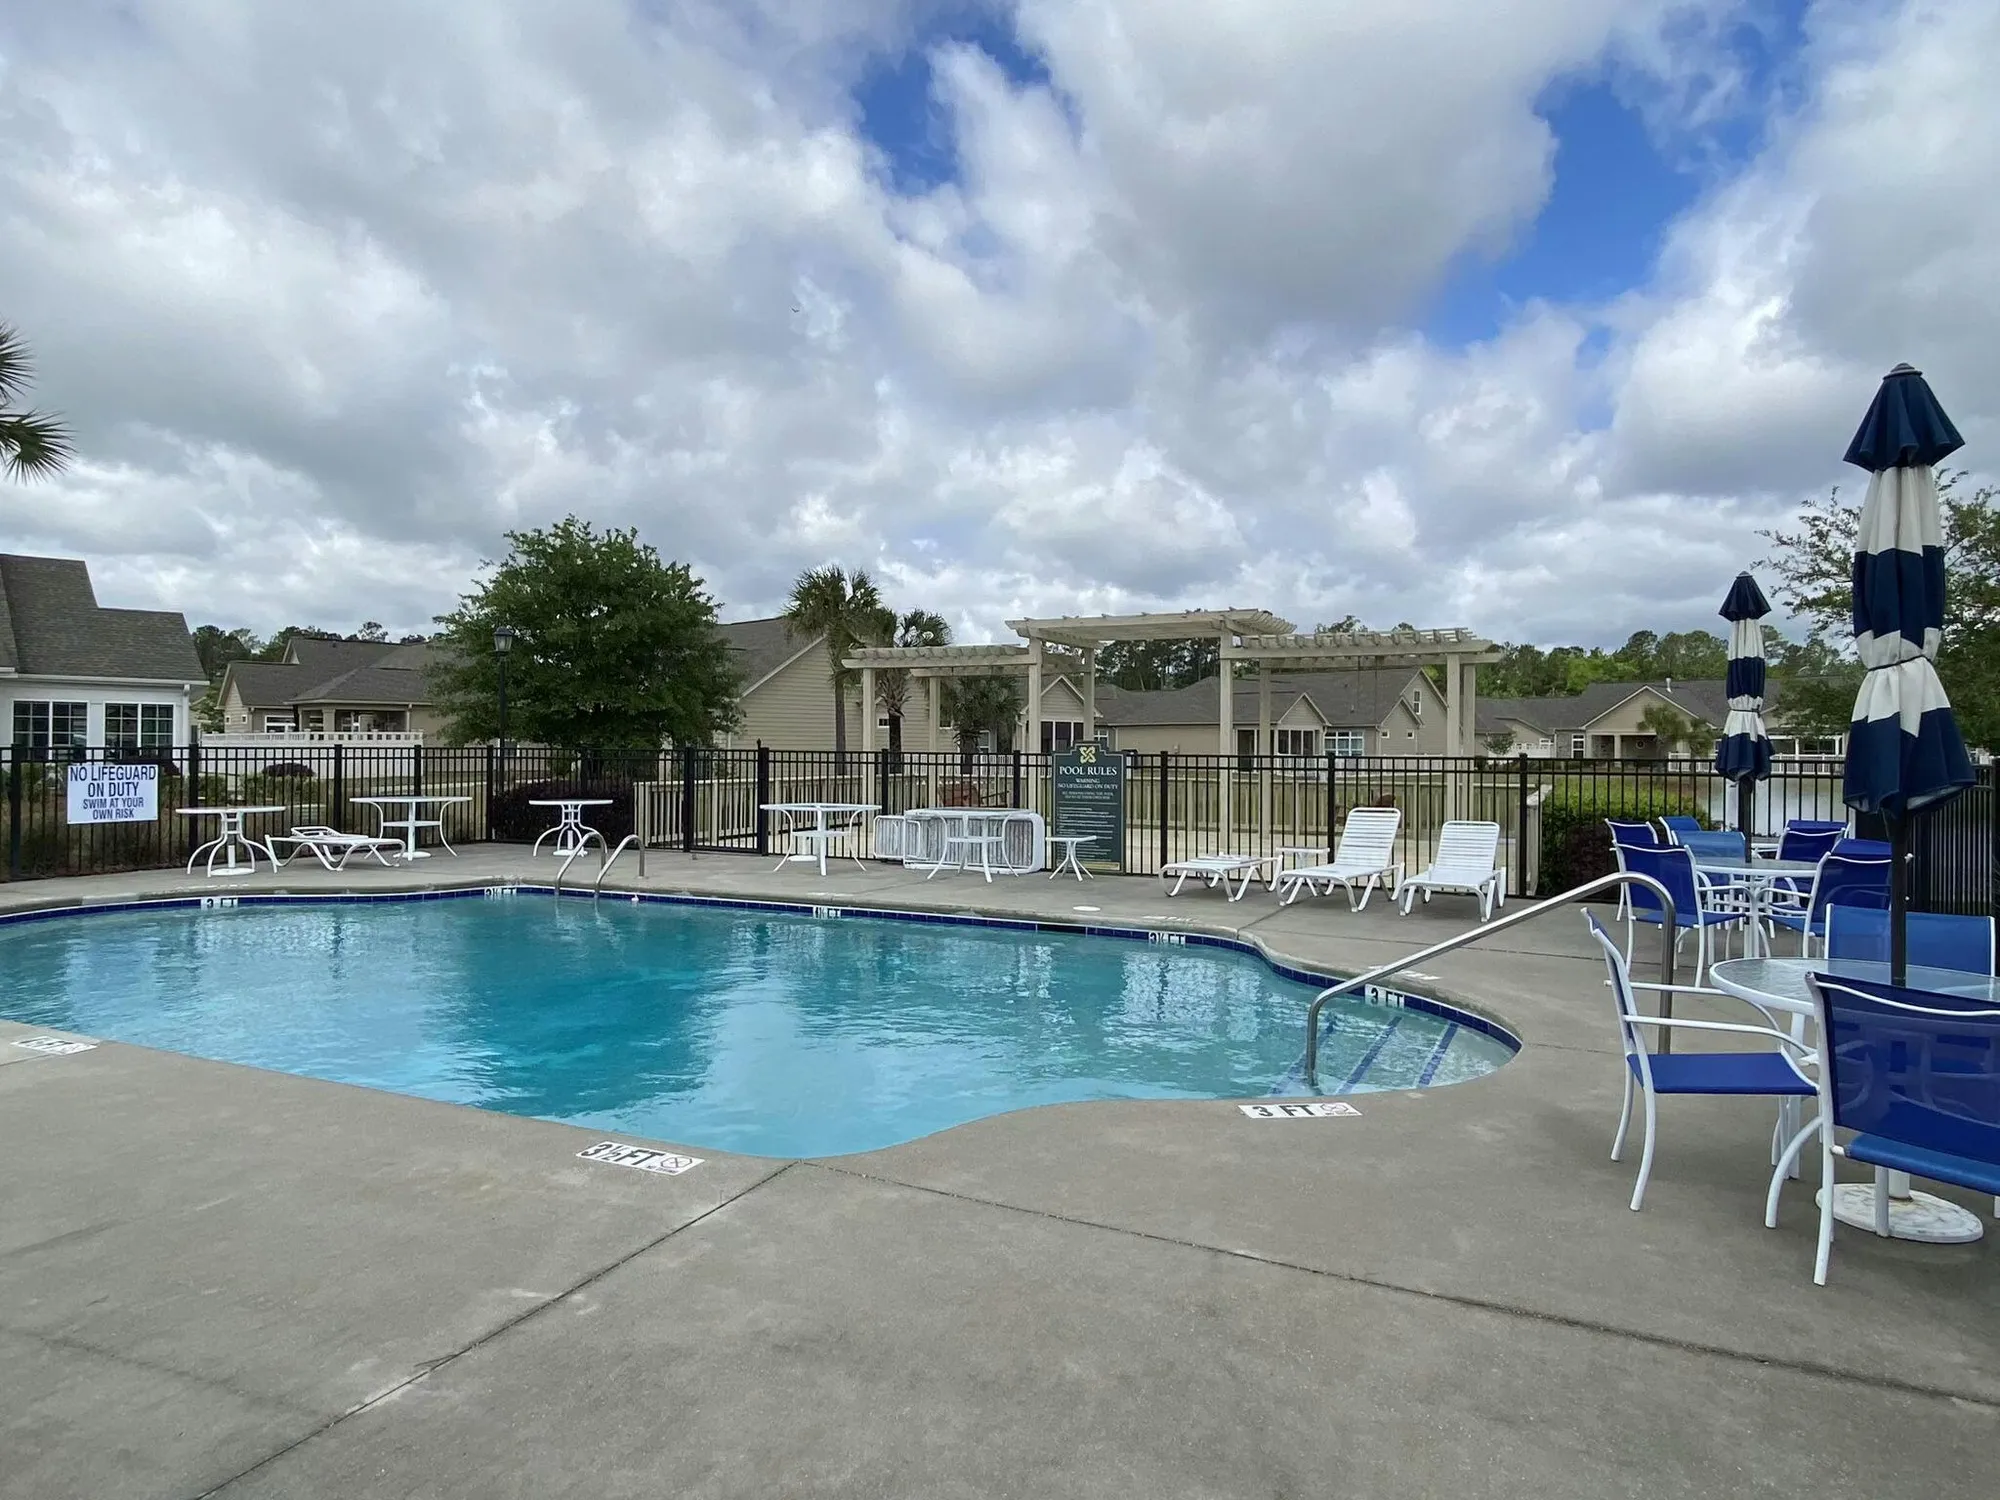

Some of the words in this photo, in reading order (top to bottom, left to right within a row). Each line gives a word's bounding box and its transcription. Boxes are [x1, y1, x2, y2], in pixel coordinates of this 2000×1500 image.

[70, 766, 87, 781] NO
[91, 766, 156, 781] LIFEGUARD
[1060, 766, 1085, 775] POOL
[1088, 766, 1117, 776] RULES
[88, 782, 104, 797] ON
[109, 781, 139, 797] DUTY
[83, 799, 107, 810] SWIM
[109, 798, 119, 808] AT
[122, 797, 144, 808] YOUR
[93, 809, 113, 820] OWN
[115, 808, 134, 819] RISK
[1252, 1105, 1273, 1117] 3
[1279, 1104, 1316, 1117] FT
